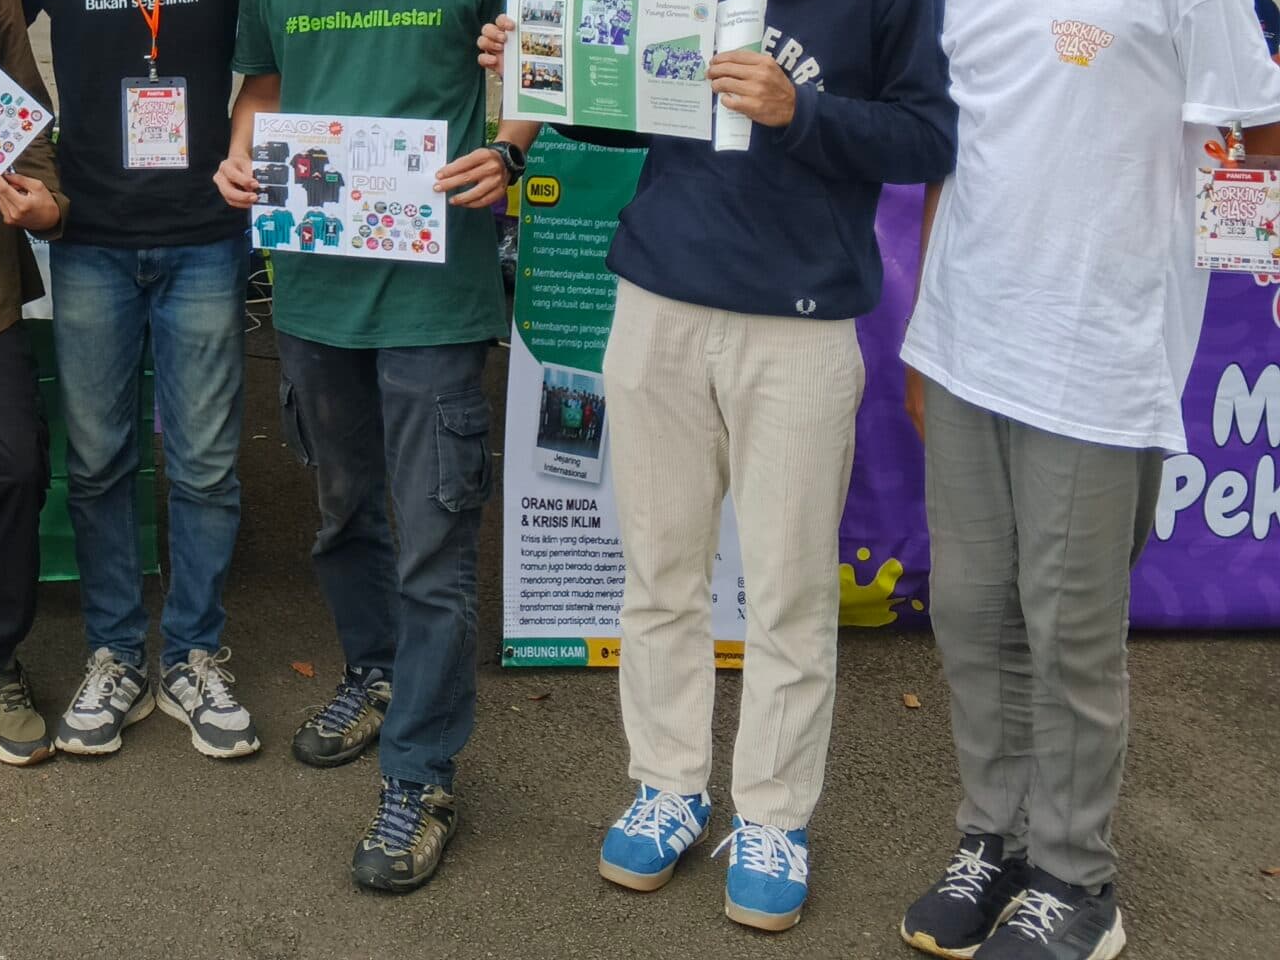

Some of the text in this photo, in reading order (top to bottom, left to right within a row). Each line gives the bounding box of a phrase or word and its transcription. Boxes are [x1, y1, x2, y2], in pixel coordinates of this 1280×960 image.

[285, 8, 443, 34] #BersihAdilLestari
[1055, 35, 1098, 61] CLASS
[258, 118, 329, 136] KAOS
[351, 175, 398, 191] PIN
[530, 183, 555, 198] MISI
[1219, 200, 1257, 219] CLASS
[533, 215, 593, 228] Mempersiapkan
[533, 231, 554, 240] muda
[556, 232, 577, 241] untuk
[532, 267, 595, 281] Memberdayakan
[566, 285, 607, 296] demokrasi
[579, 301, 594, 310] dan
[531, 321, 578, 334] Membangun
[543, 463, 588, 479] Internasional
[521, 497, 599, 511] ORANG MUDA
[521, 515, 601, 528] & KRISIS IKLIM
[521, 534, 541, 543] Krisis
[559, 537, 577, 546] yang
[521, 549, 600, 559] korupsi pemerintahan
[520, 563, 548, 571] namun
[548, 562, 564, 573] juga
[593, 562, 618, 572] dalam
[520, 576, 562, 586] mendorong
[552, 590, 570, 598] anak
[571, 590, 594, 599] muda
[520, 603, 564, 612] transformasi
[519, 617, 613, 626] demokrasi dan
[514, 646, 586, 658] HUBUNGI KAMI
